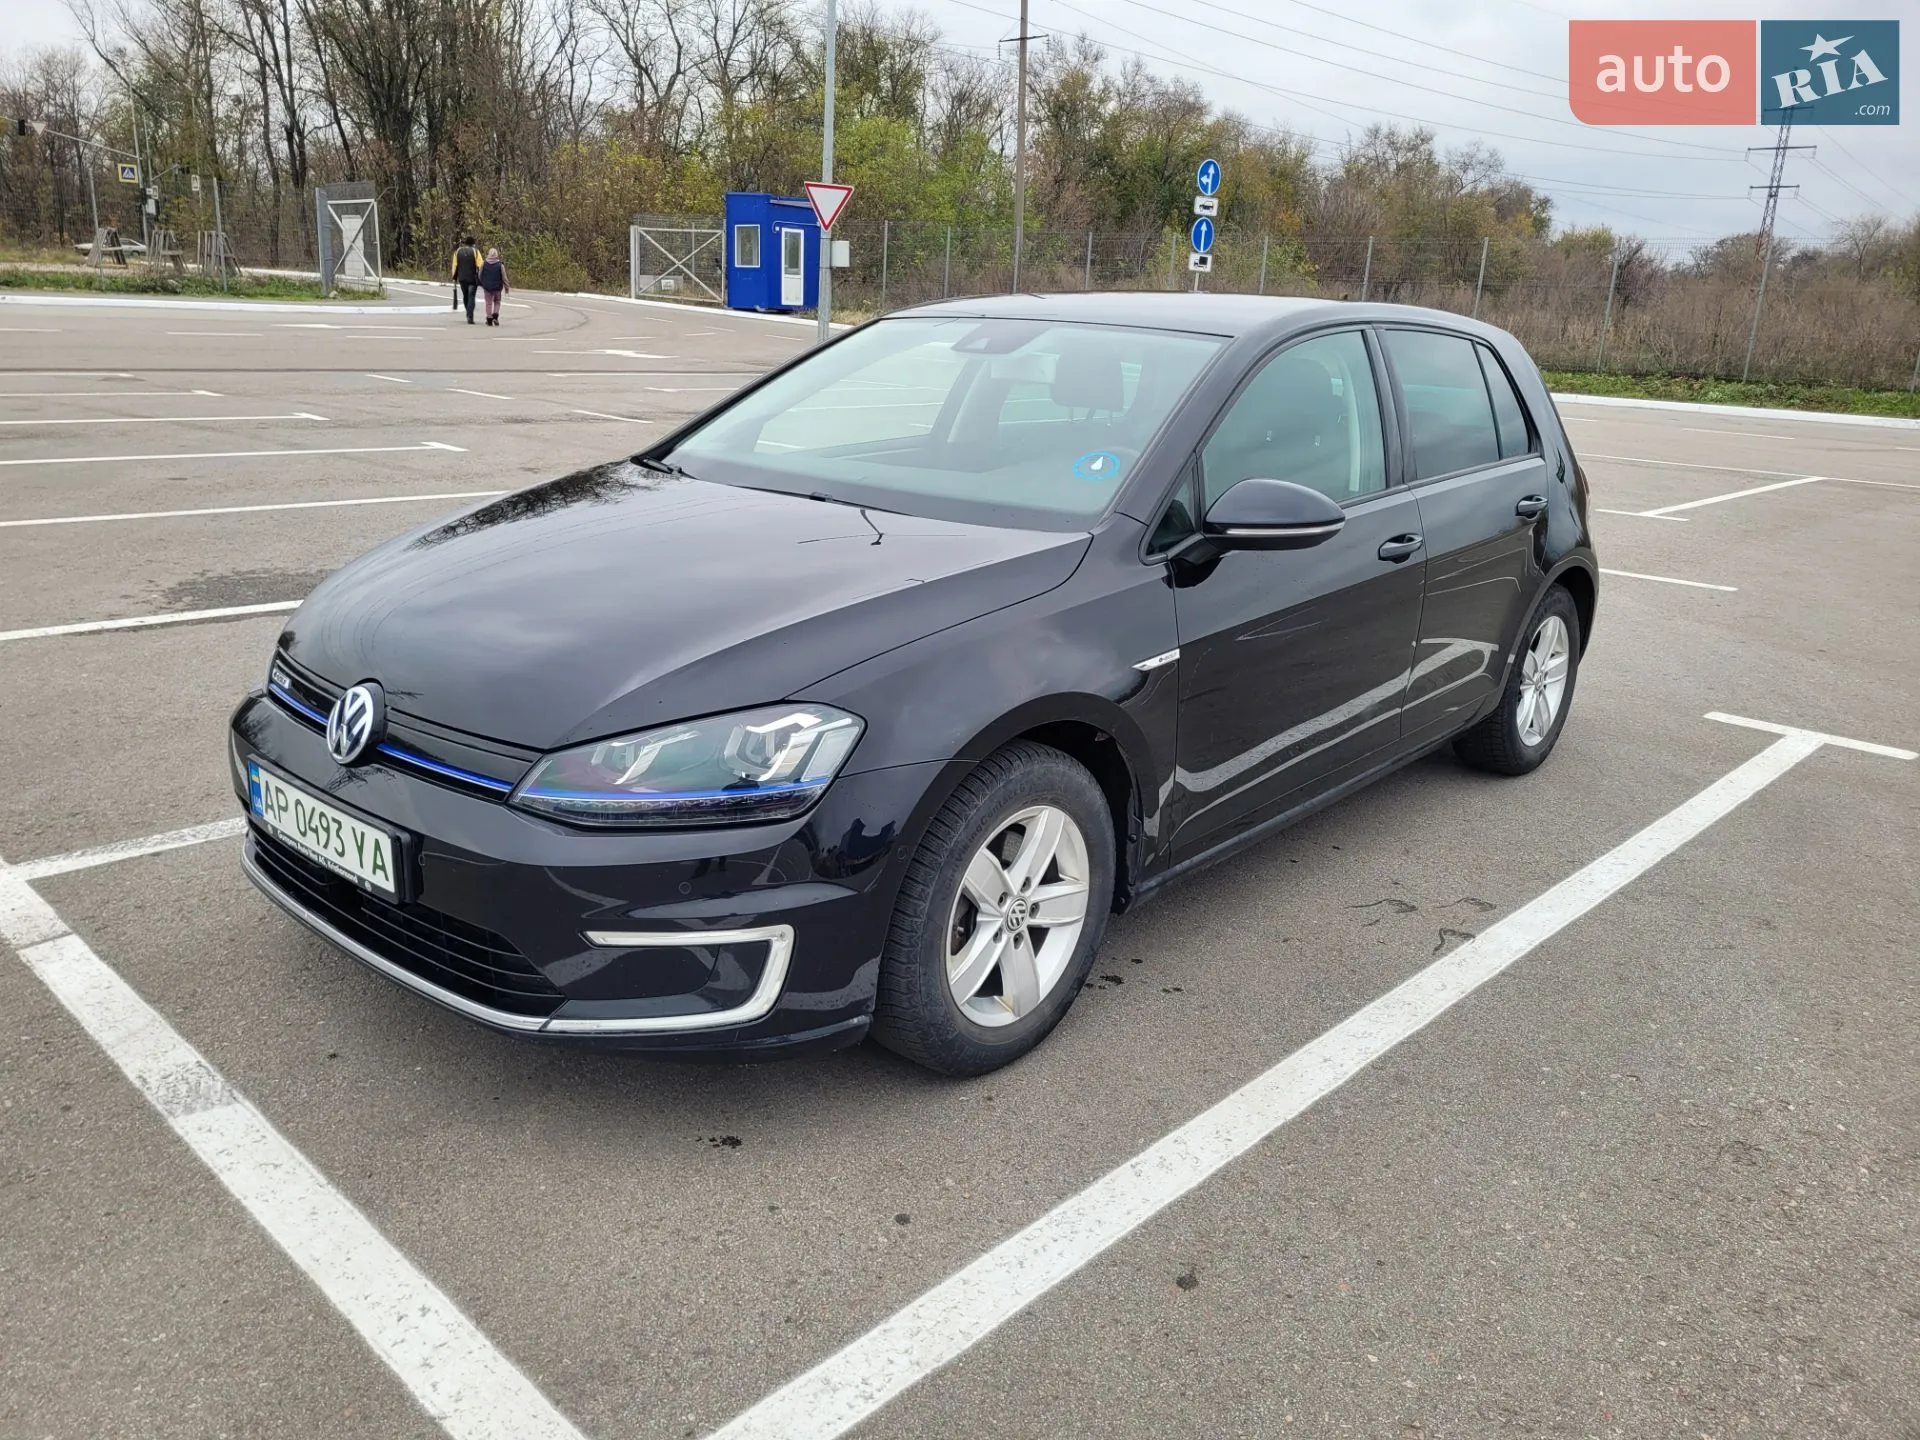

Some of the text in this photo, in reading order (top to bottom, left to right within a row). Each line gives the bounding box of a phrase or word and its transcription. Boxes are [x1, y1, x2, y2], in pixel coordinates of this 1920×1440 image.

[254, 795, 263, 810] UA
[264, 780, 390, 882] AP 0493 YA
